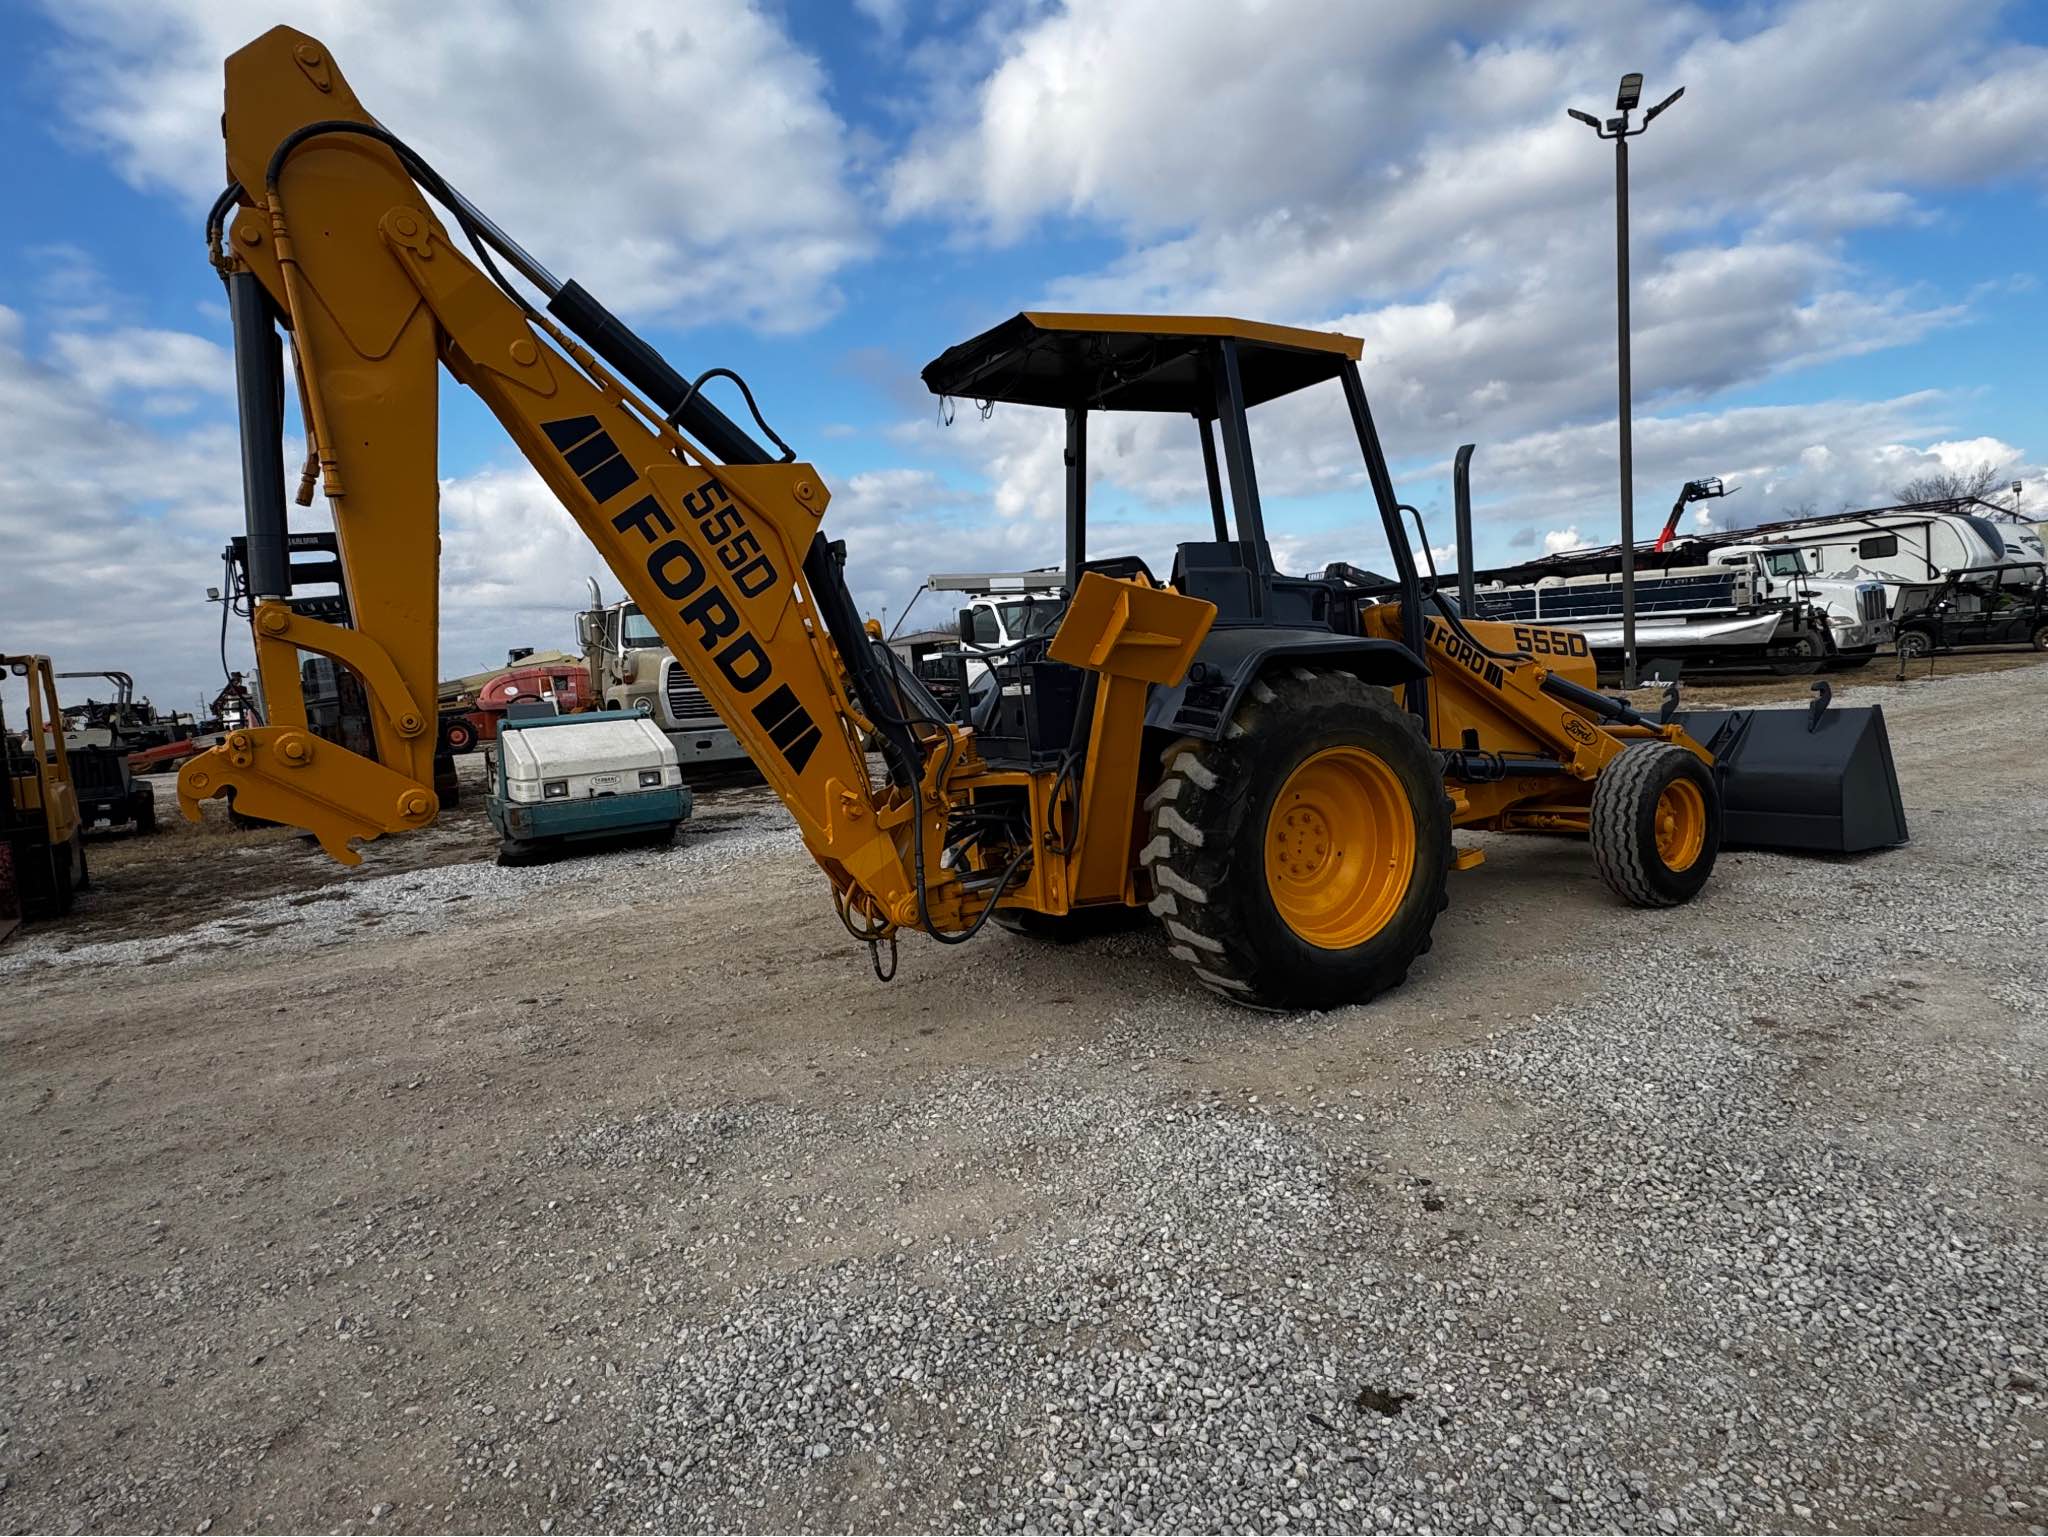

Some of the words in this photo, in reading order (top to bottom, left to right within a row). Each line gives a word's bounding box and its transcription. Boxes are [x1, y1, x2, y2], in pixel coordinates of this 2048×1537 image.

[682, 479, 778, 599] 555D
[611, 494, 773, 693] FORD
[1434, 626, 1486, 674] FORD
[1514, 627, 1588, 657] 555D
